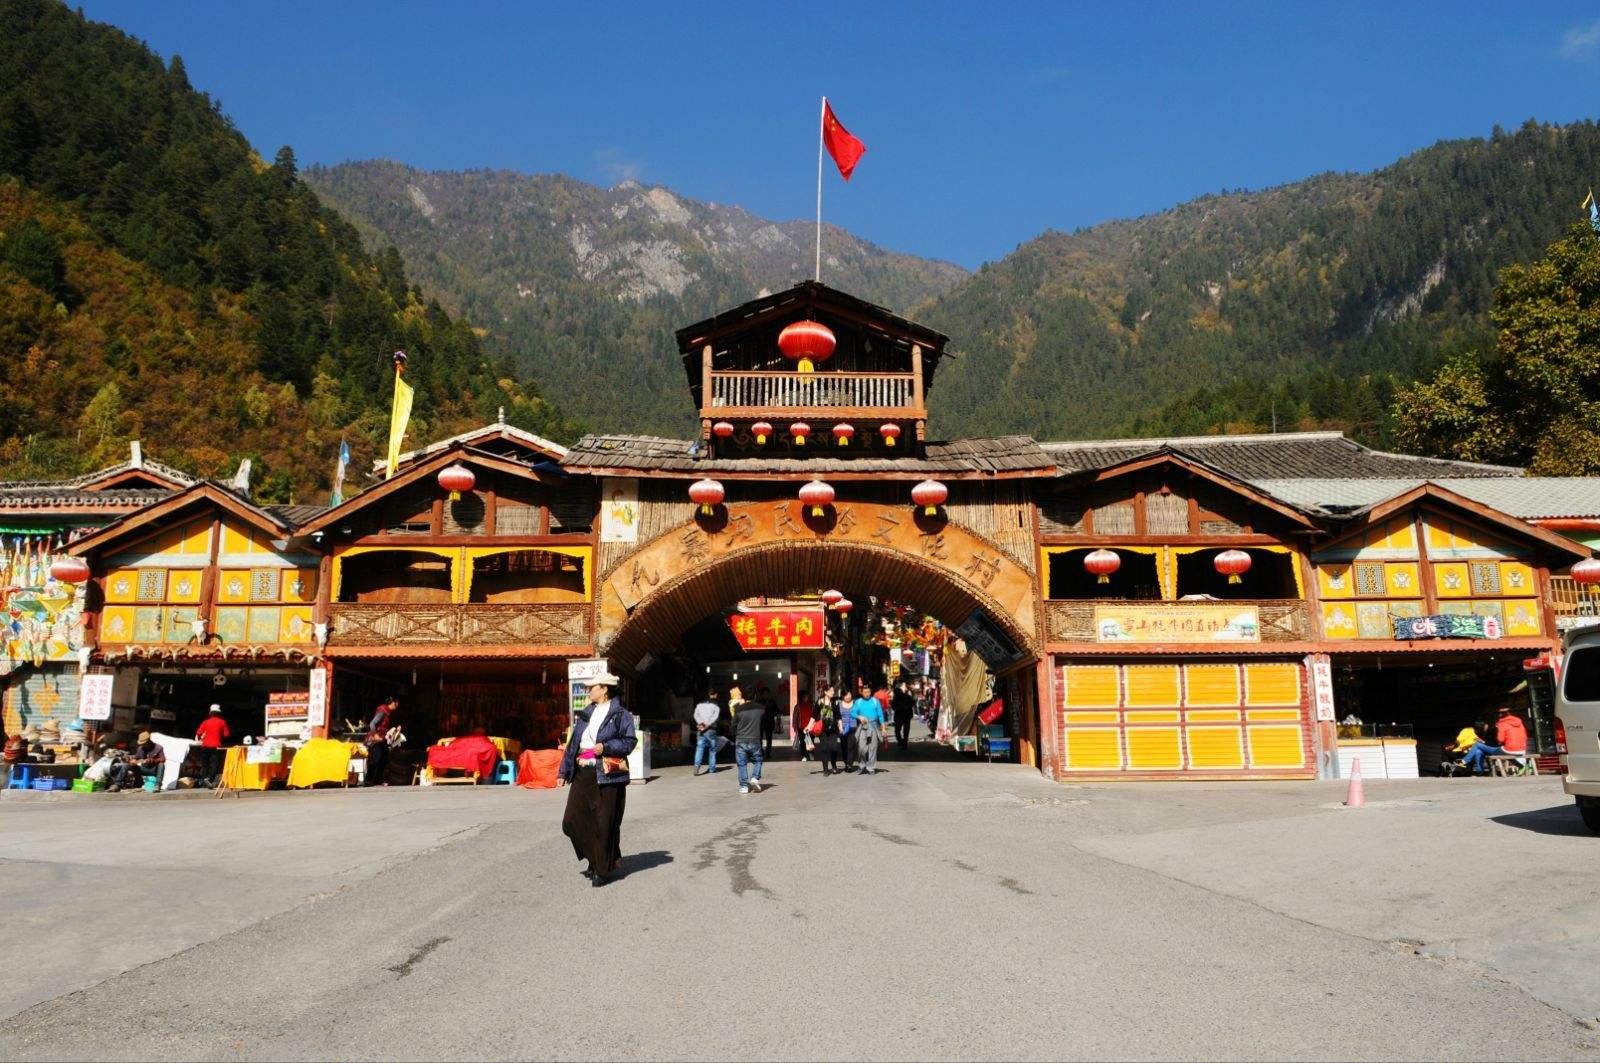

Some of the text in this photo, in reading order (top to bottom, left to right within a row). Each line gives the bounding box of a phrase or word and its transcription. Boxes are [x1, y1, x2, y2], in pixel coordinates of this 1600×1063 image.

[735, 616, 813, 637] 牦牛肉
[1317, 666, 1331, 718] 牦牛酸奶
